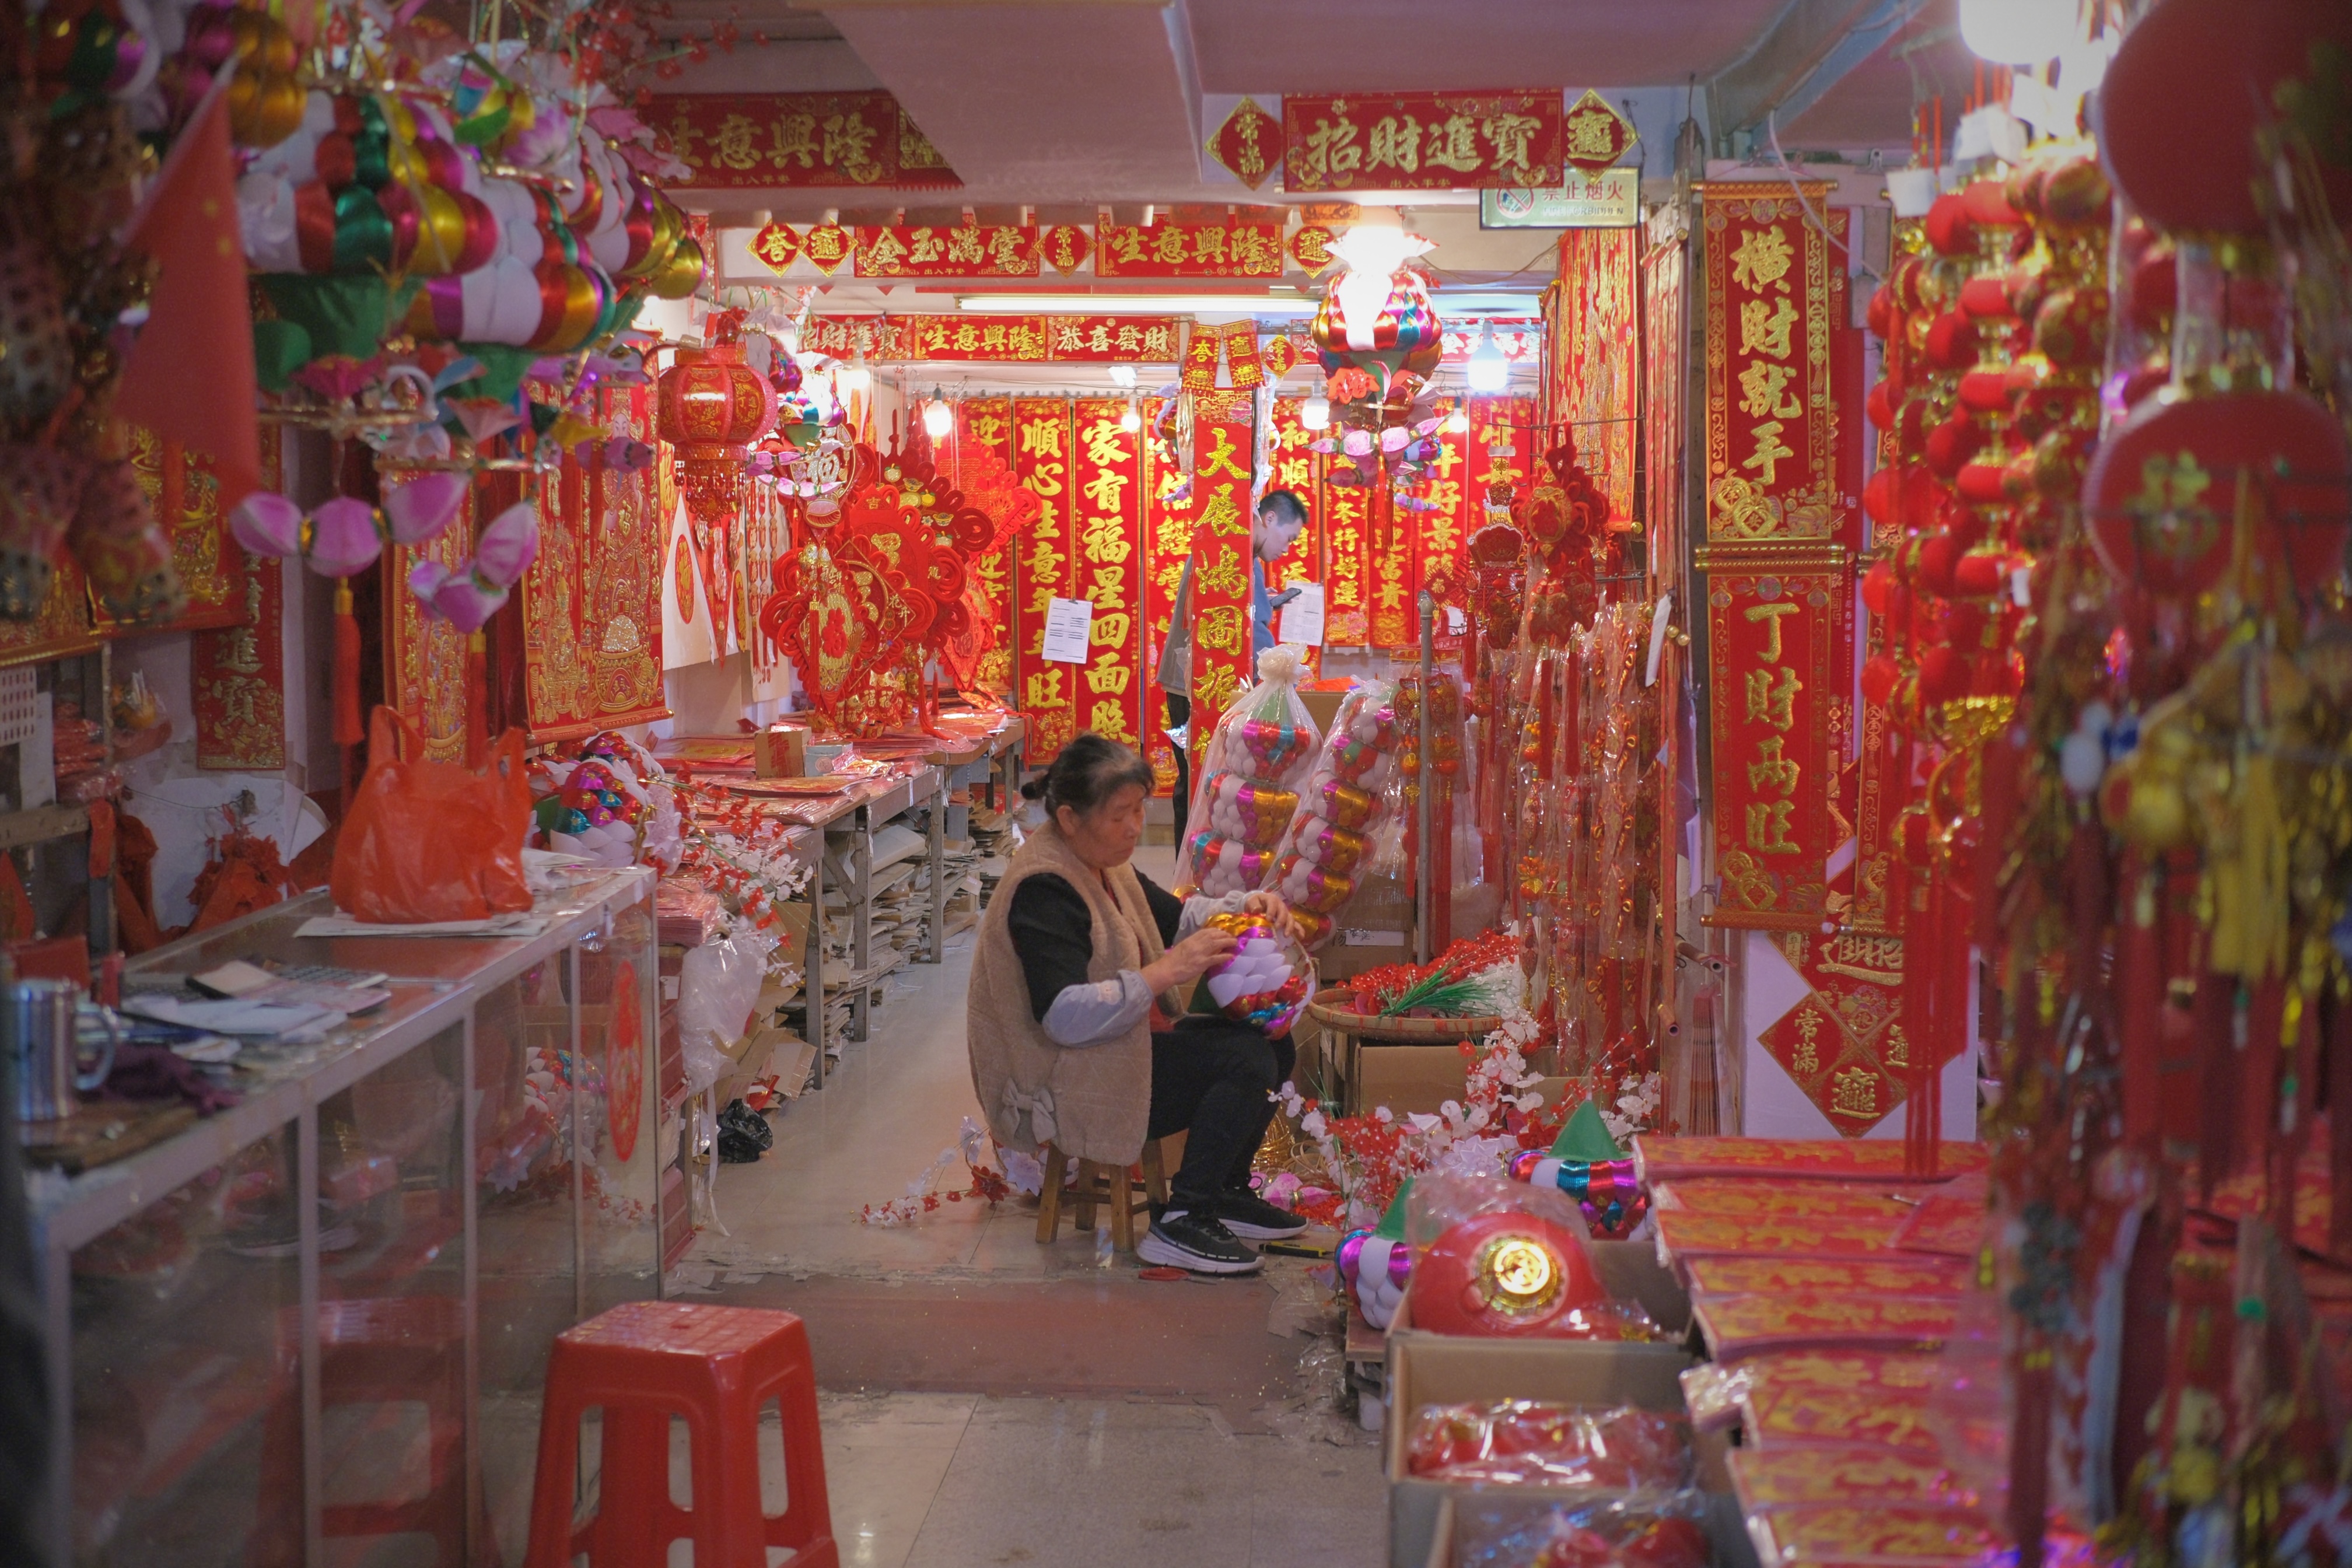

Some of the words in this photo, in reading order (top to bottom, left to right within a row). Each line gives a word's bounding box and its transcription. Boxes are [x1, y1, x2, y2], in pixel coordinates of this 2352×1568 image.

[1304, 116, 1542, 174] 招財進寶
[1112, 226, 1268, 264] 生意興隆
[925, 324, 1030, 352] 生意興隆
[1057, 324, 1170, 354] 恭喜發財
[1082, 419, 1132, 744] 家有福星四面照
